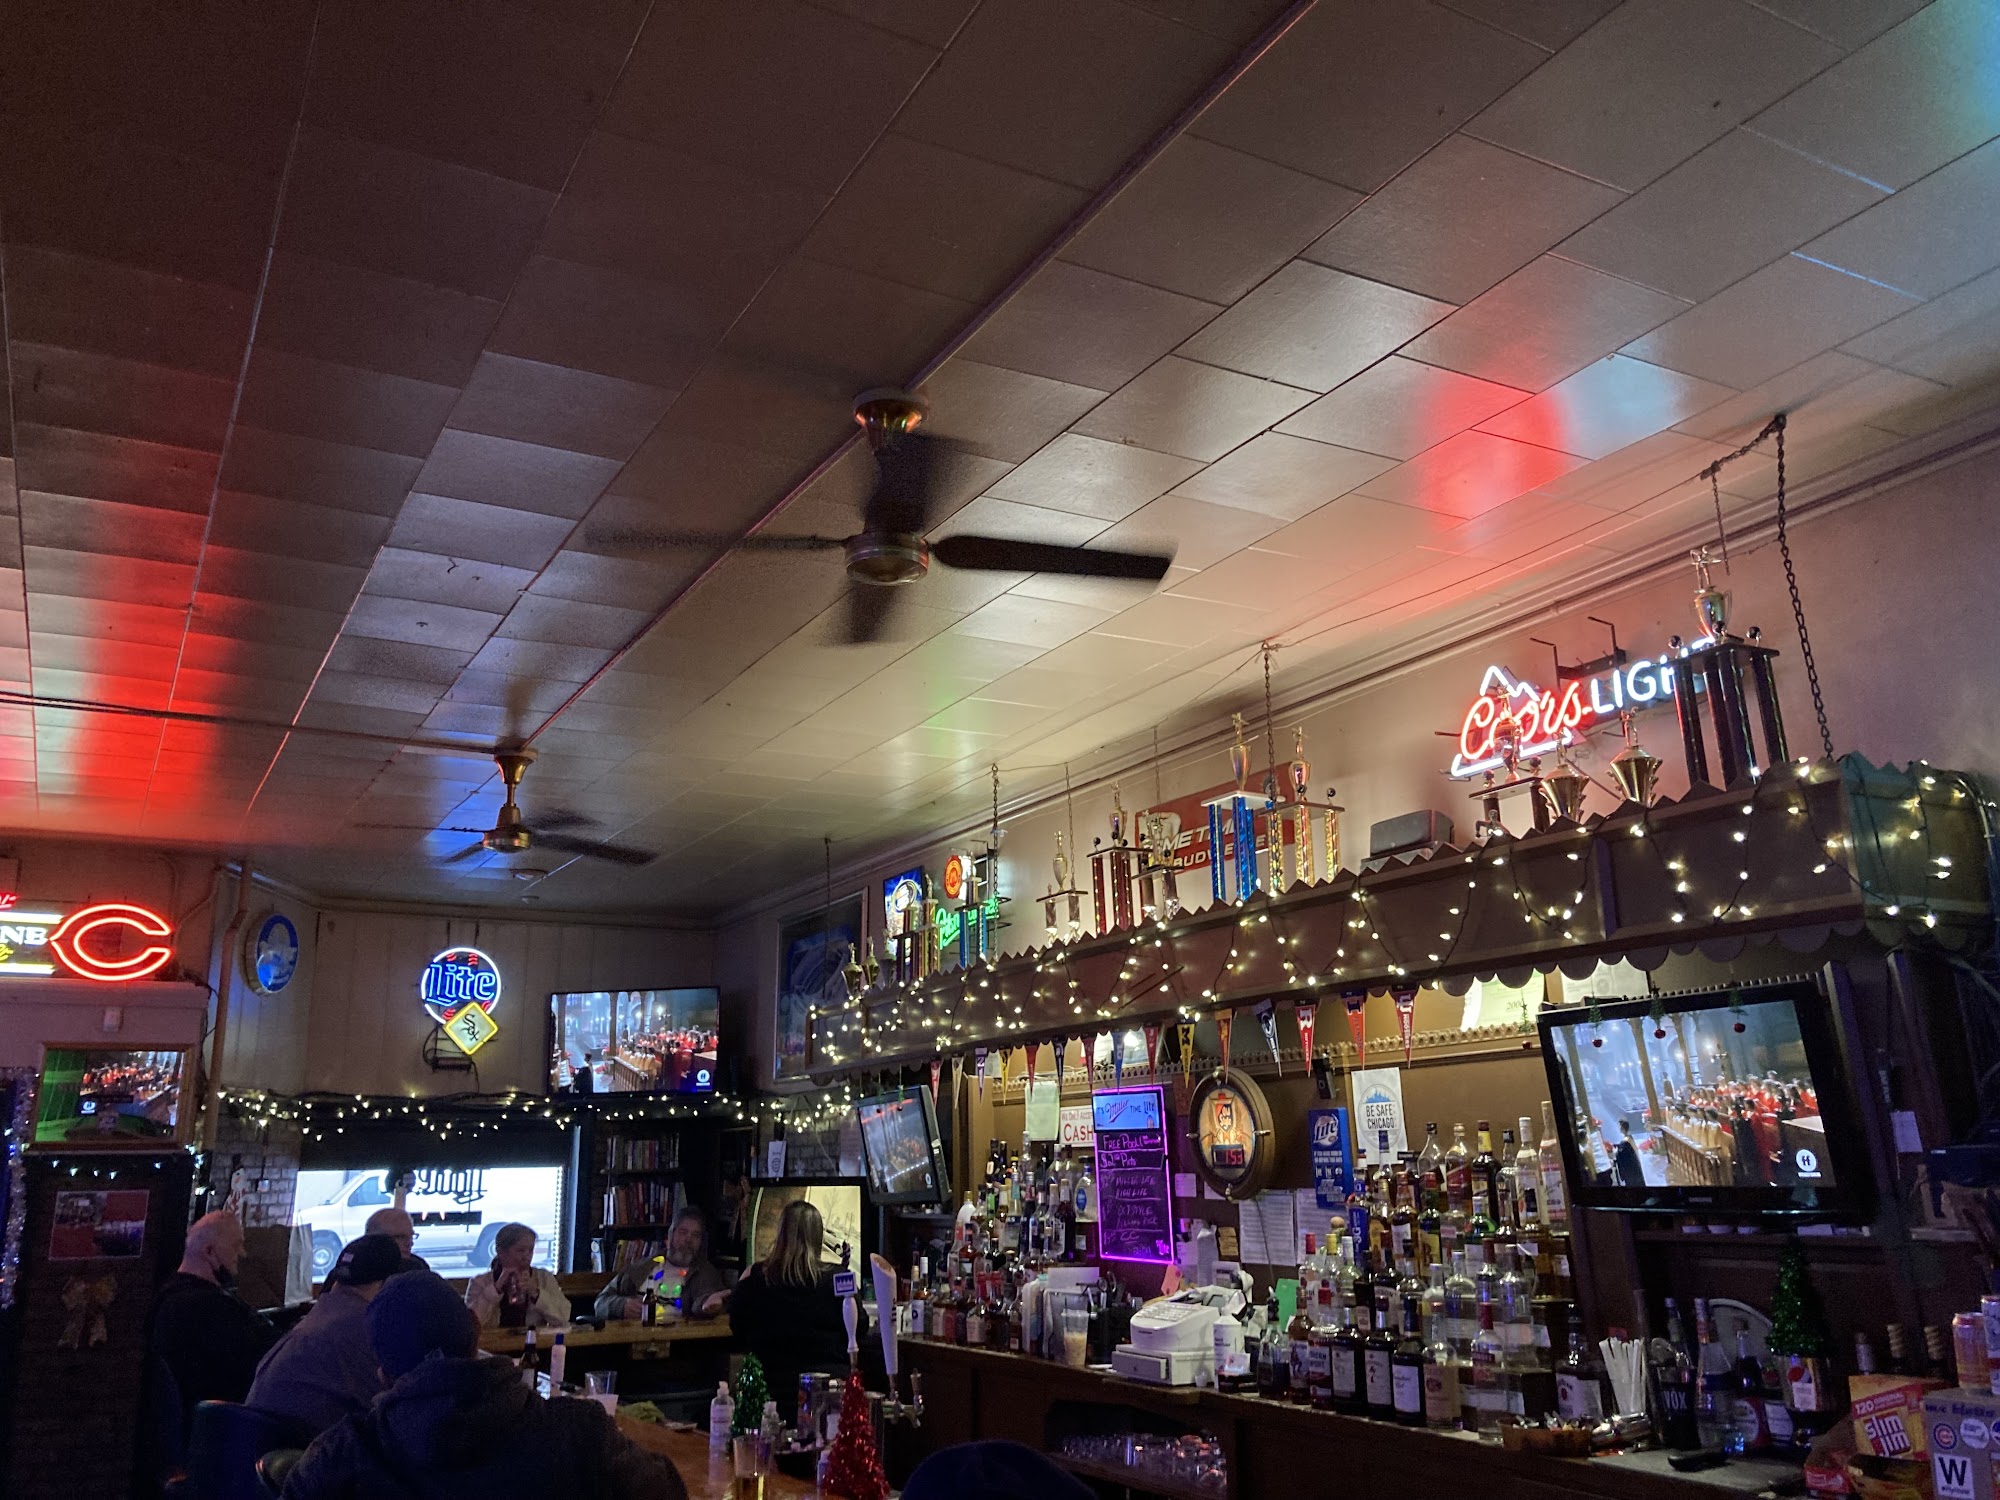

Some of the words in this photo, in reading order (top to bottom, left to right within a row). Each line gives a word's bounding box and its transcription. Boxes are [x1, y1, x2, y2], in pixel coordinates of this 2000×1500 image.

[426, 964, 495, 1006] Lite
[461, 1014, 479, 1041] Sox
[1300, 1008, 1313, 1030] R
[1182, 1027, 1190, 1045] M
[1105, 1099, 1129, 1121] Miller
[1143, 1100, 1155, 1114] Lite
[1365, 1105, 1374, 1117] BE
[1375, 1104, 1393, 1117] SAFE
[1063, 1123, 1094, 1142] CASH
[1315, 1121, 1337, 1142] Lite
[1367, 1117, 1395, 1129] CHICAGO
[1663, 1390, 1687, 1410] VOX
[1855, 1400, 1874, 1415] 120
[1938, 1457, 1967, 1486] W
